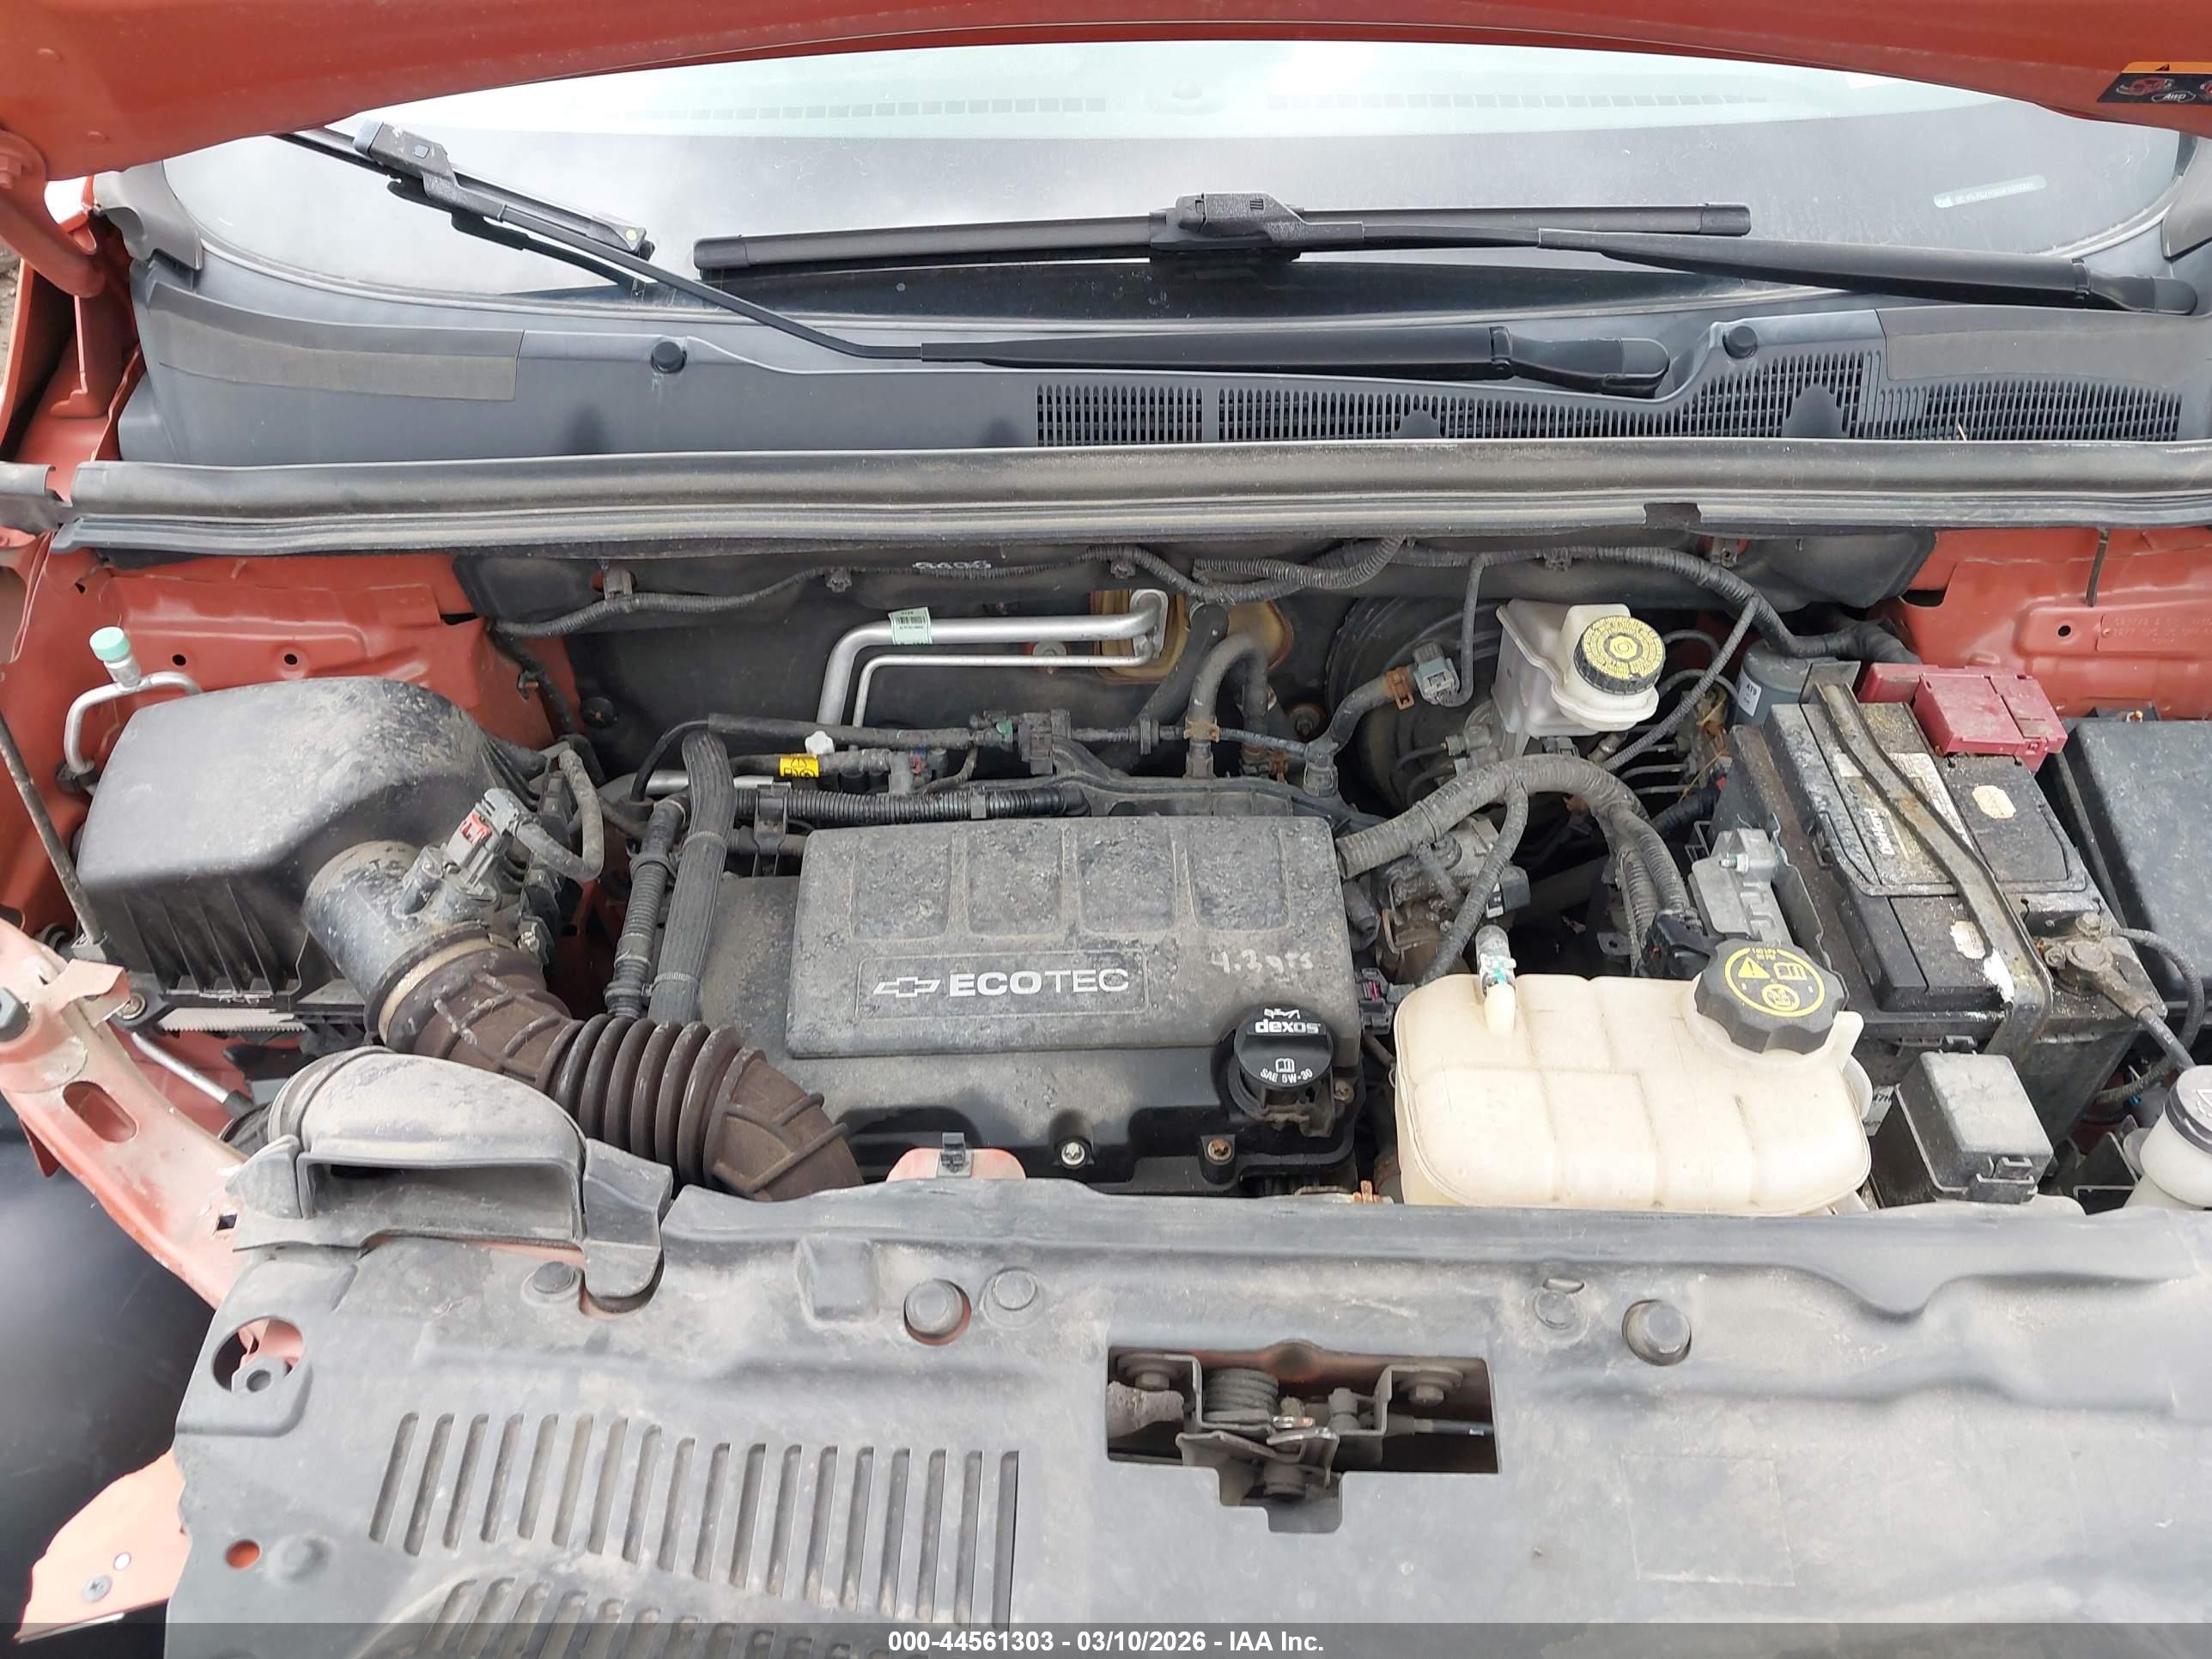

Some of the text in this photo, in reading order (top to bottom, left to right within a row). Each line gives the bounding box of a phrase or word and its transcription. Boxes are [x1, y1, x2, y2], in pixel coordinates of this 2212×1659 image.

[949, 968, 1129, 997] ECOTEC
[1255, 1018, 1319, 1035] dexos
[1260, 1067, 1313, 1084] SAE 5W-30
